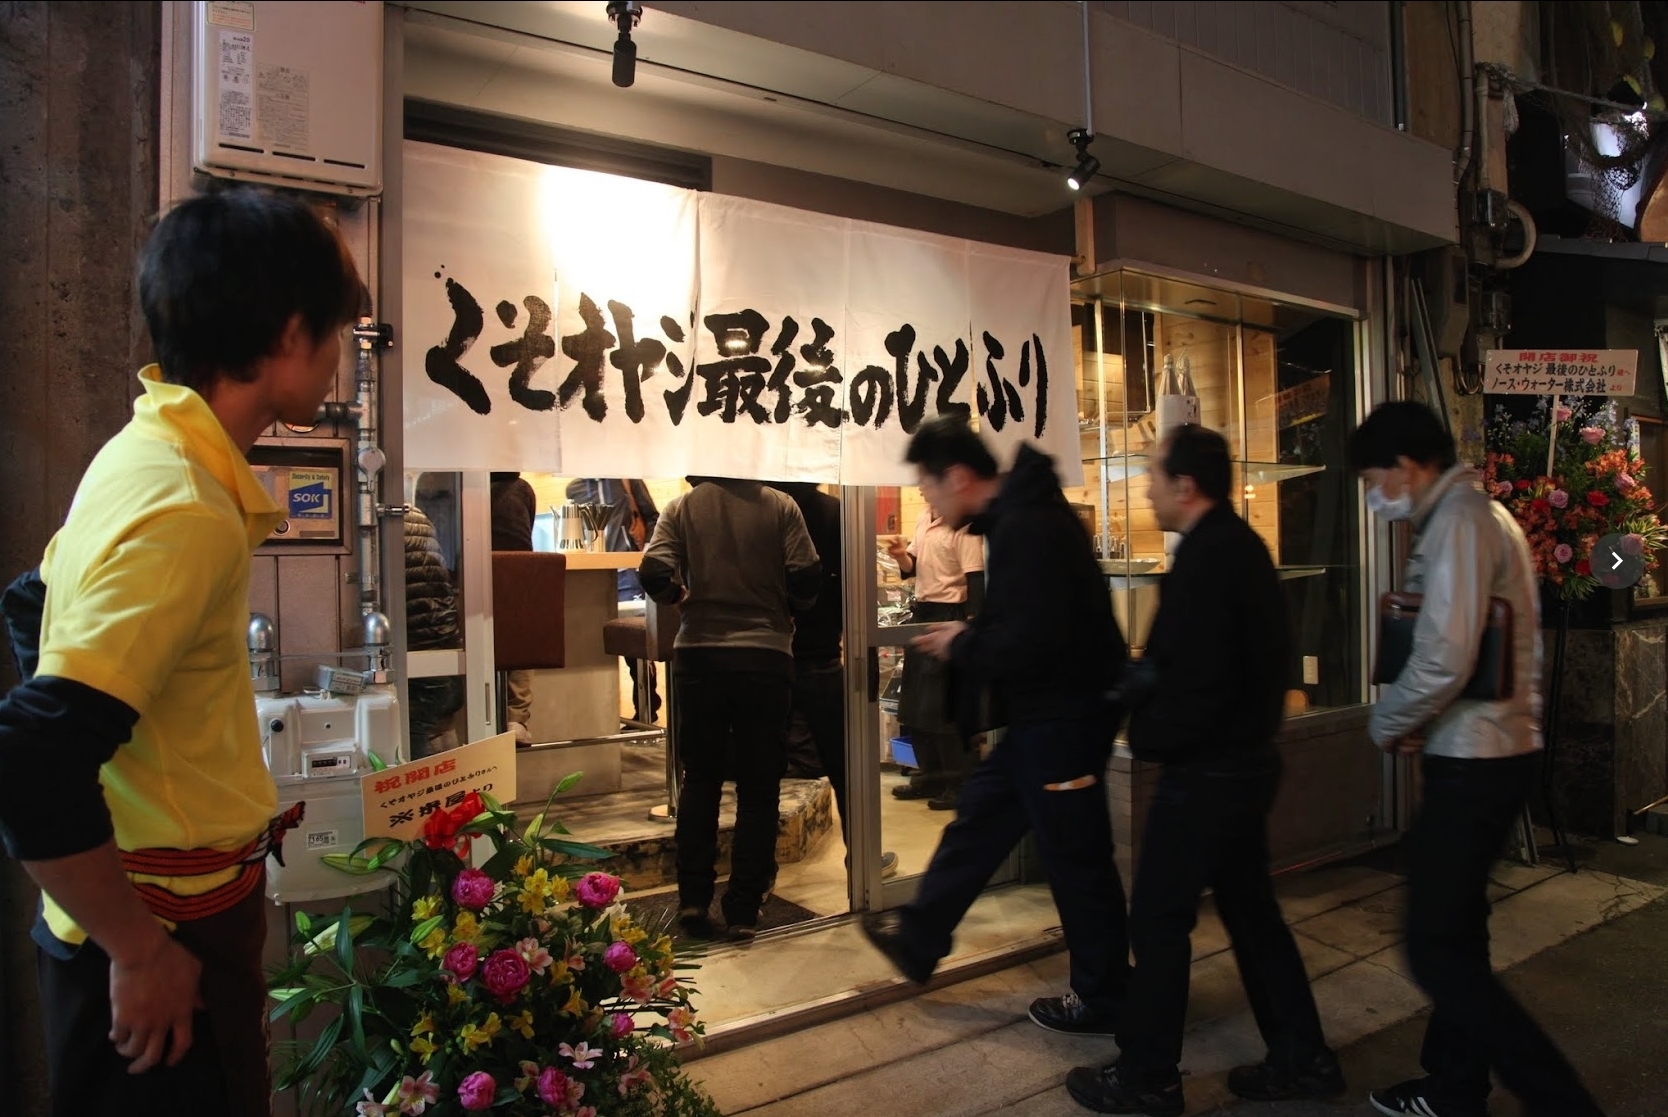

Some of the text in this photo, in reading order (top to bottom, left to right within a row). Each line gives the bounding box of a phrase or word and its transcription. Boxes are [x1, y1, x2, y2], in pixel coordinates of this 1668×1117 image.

[1518, 352, 1599, 363] 開店御祝
[292, 473, 311, 481] Security
[373, 758, 457, 795] 祝開店
